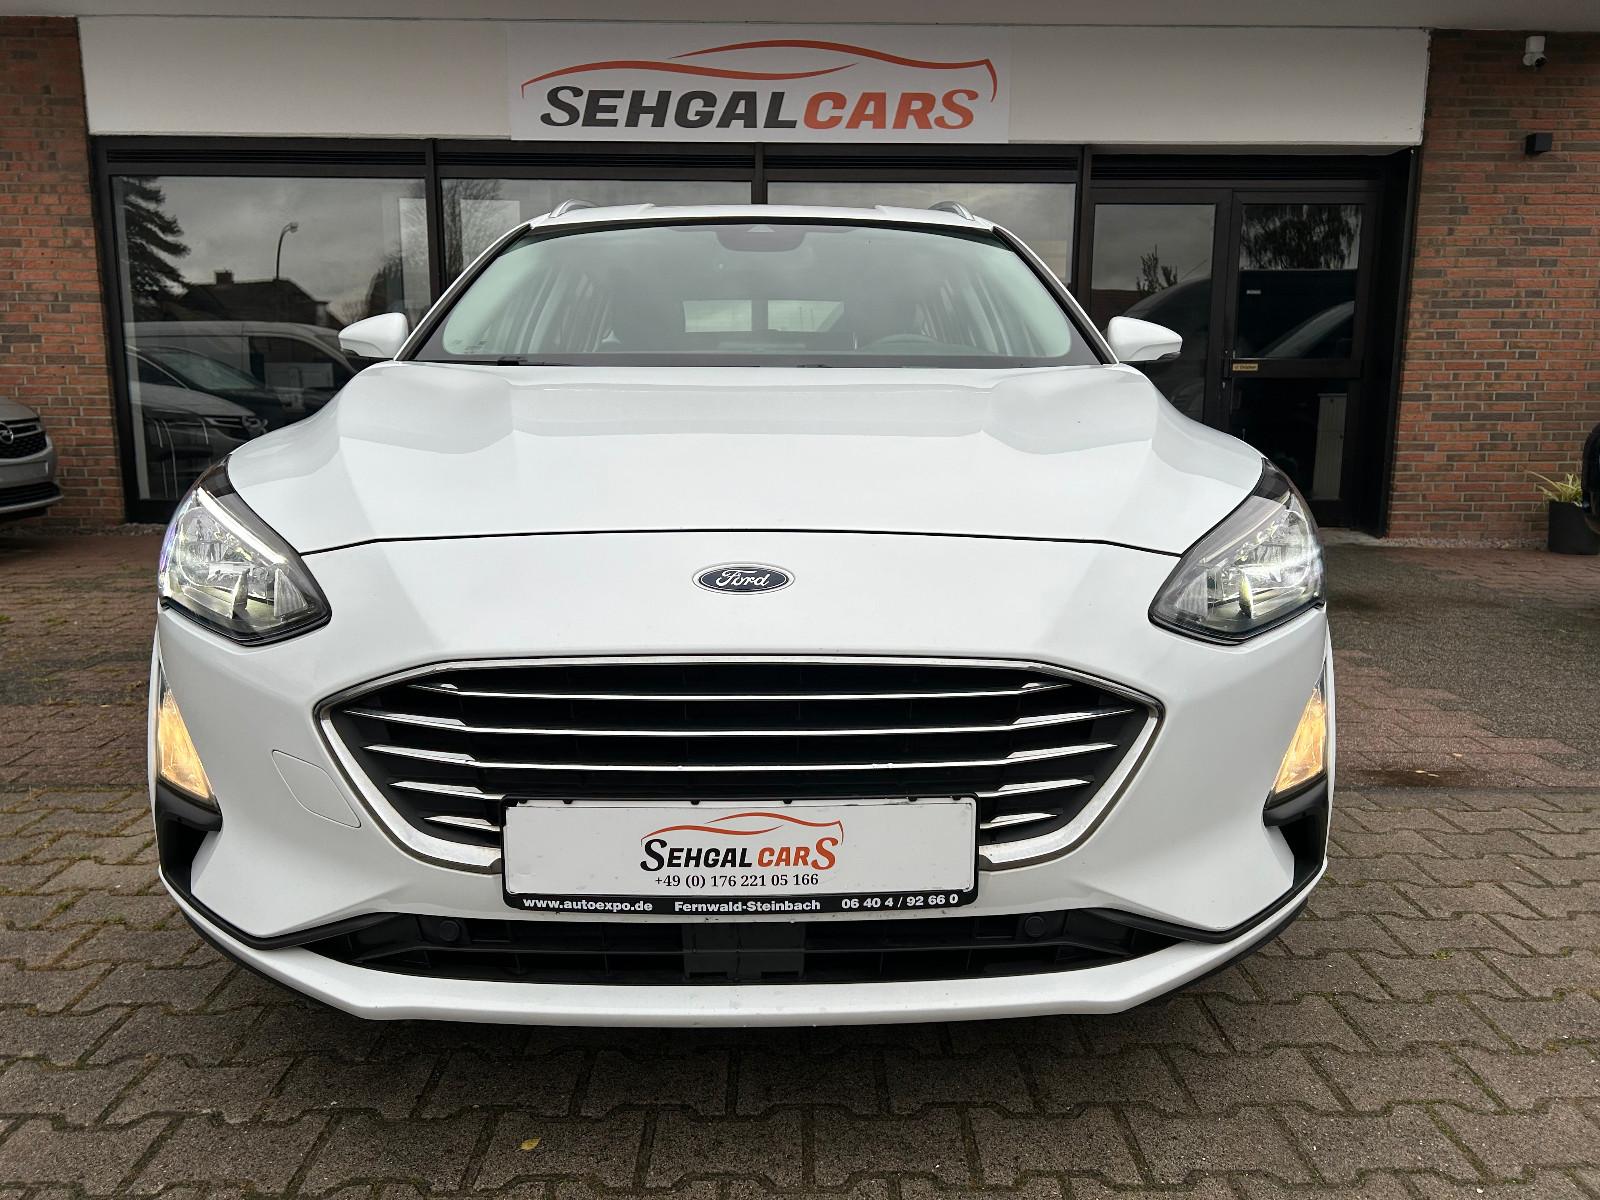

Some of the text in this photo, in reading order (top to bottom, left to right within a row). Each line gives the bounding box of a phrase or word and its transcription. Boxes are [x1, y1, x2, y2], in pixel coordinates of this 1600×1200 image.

[715, 569, 771, 587] Ford
[640, 838, 753, 872] SEHGAL
[655, 873, 819, 889] +49 (0) 176 221 05 166
[522, 898, 653, 913] www.autoexpo.de
[674, 900, 821, 912] Fernwald-Steinbach
[841, 898, 860, 909] 06
[863, 897, 881, 908] 40
[884, 897, 894, 908] 4
[906, 895, 924, 907] 92
[928, 894, 946, 905] 66
[949, 893, 959, 904] 0
